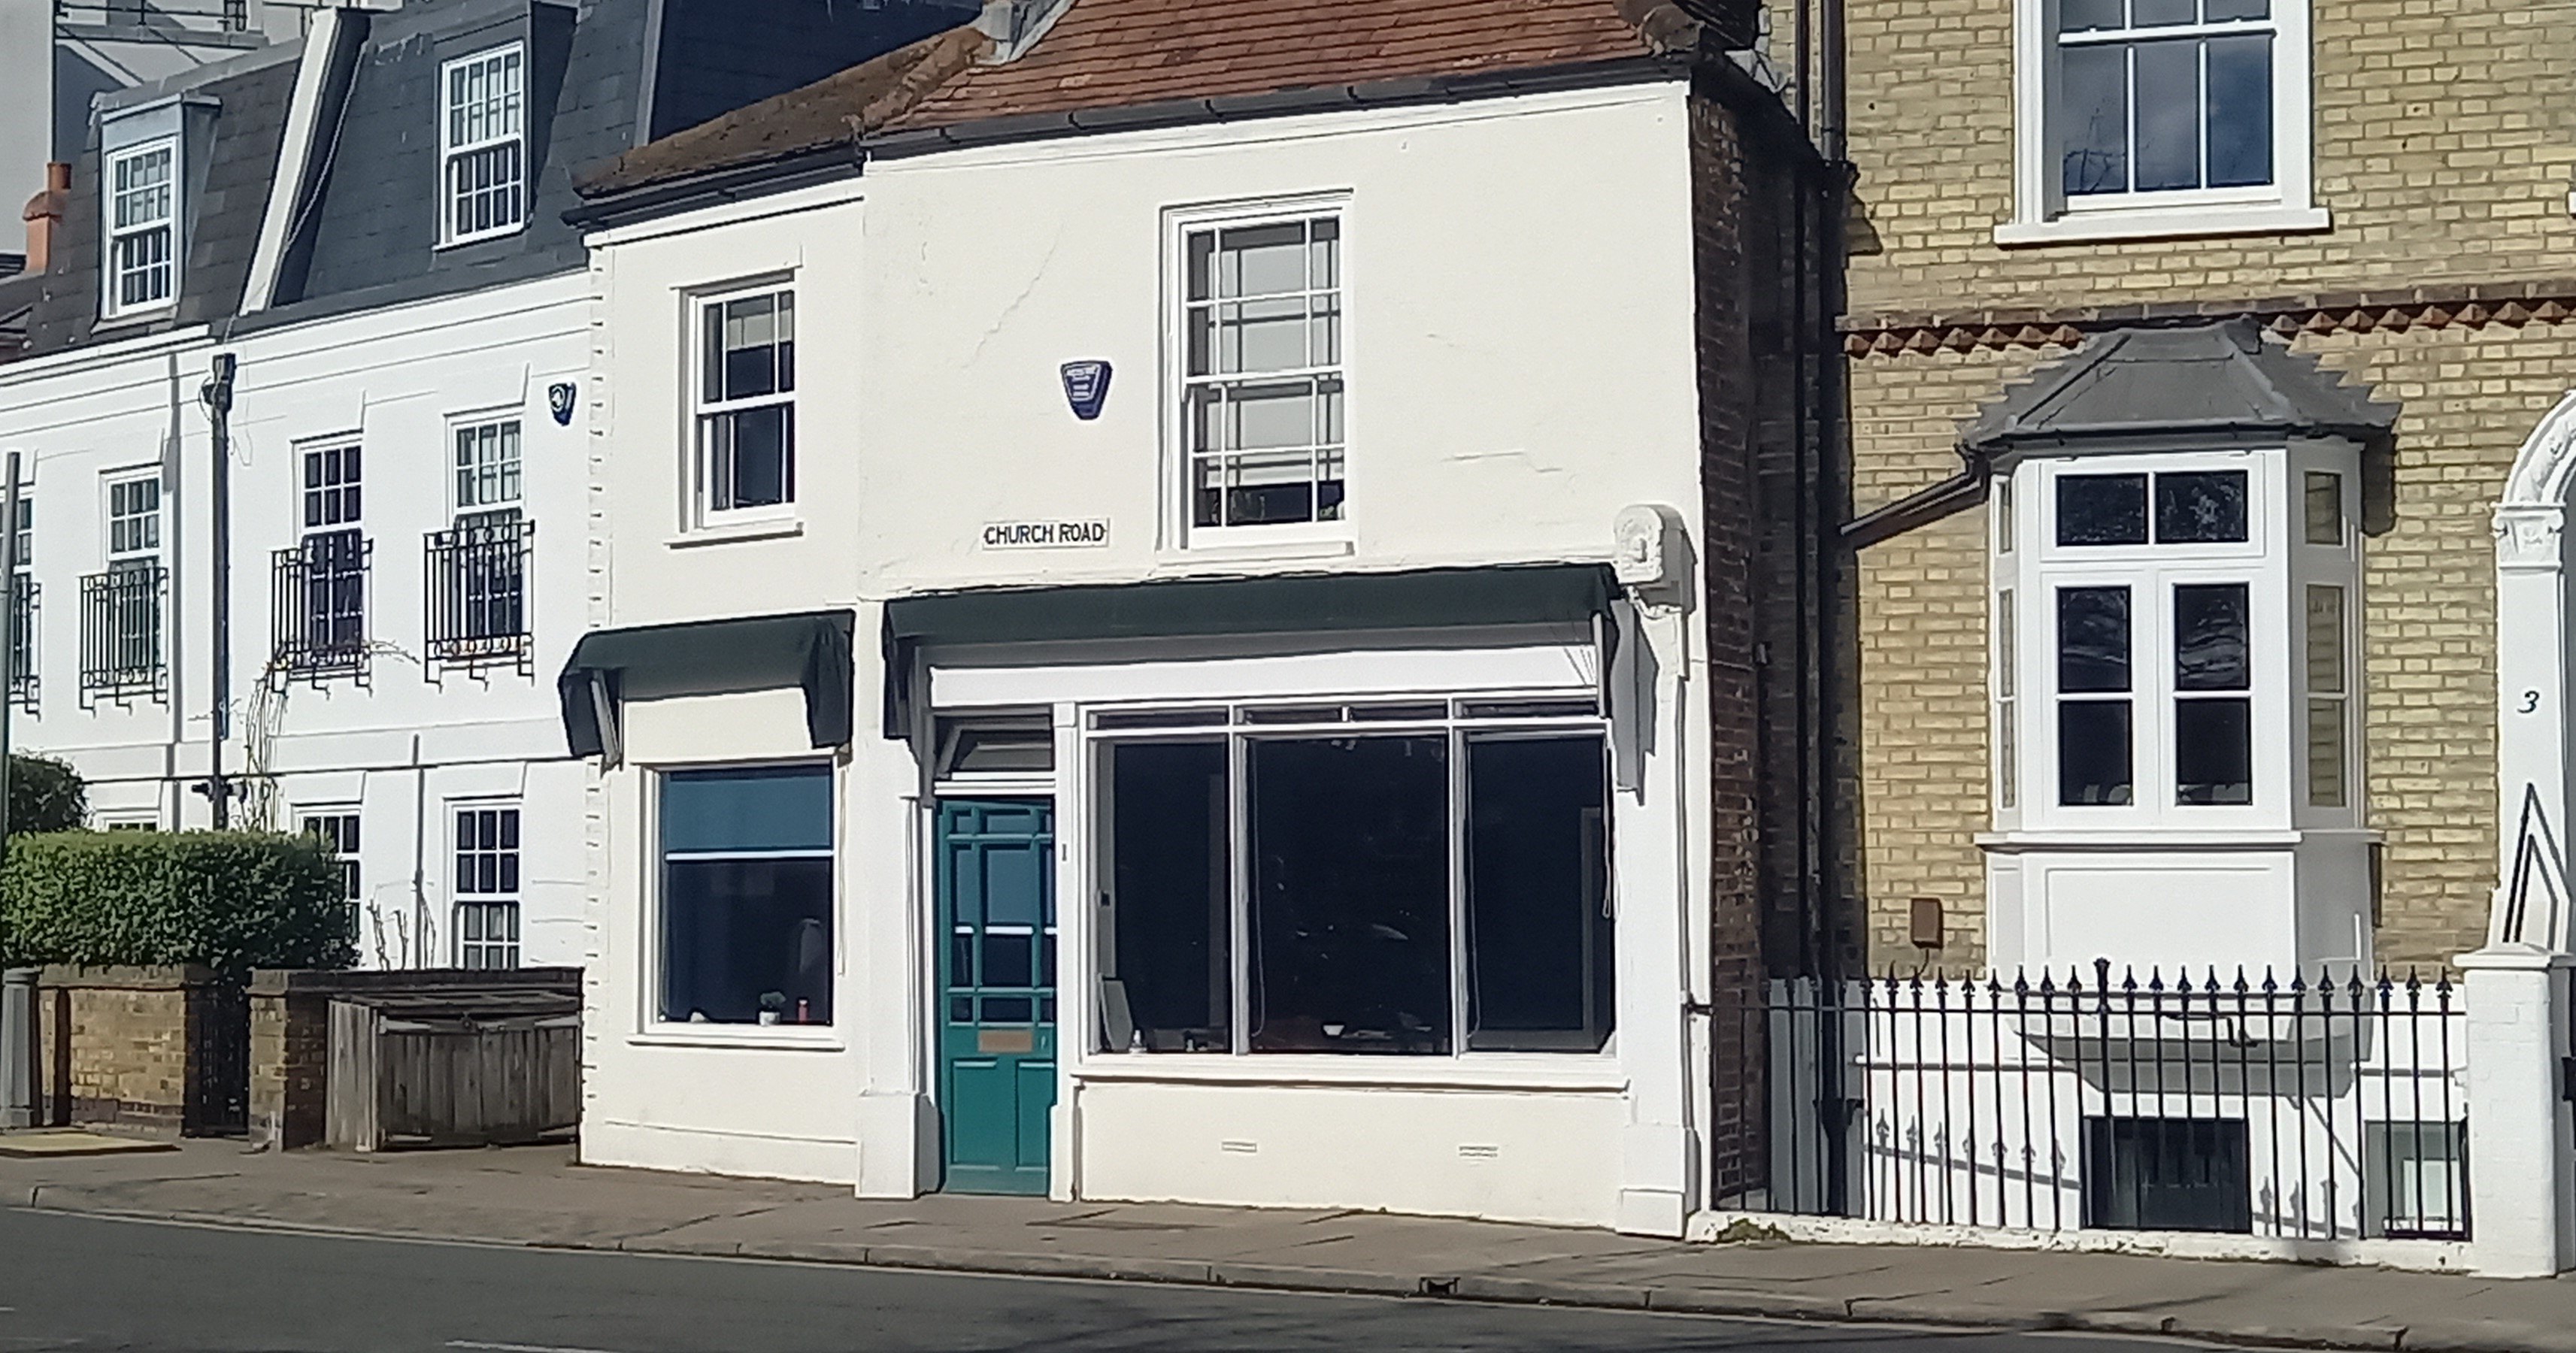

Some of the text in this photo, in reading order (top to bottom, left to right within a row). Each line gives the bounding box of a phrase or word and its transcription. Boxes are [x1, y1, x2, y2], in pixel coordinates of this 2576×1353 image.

[983, 523, 1105, 544] CHURCH ROAD
[2517, 690, 2539, 713] 3
